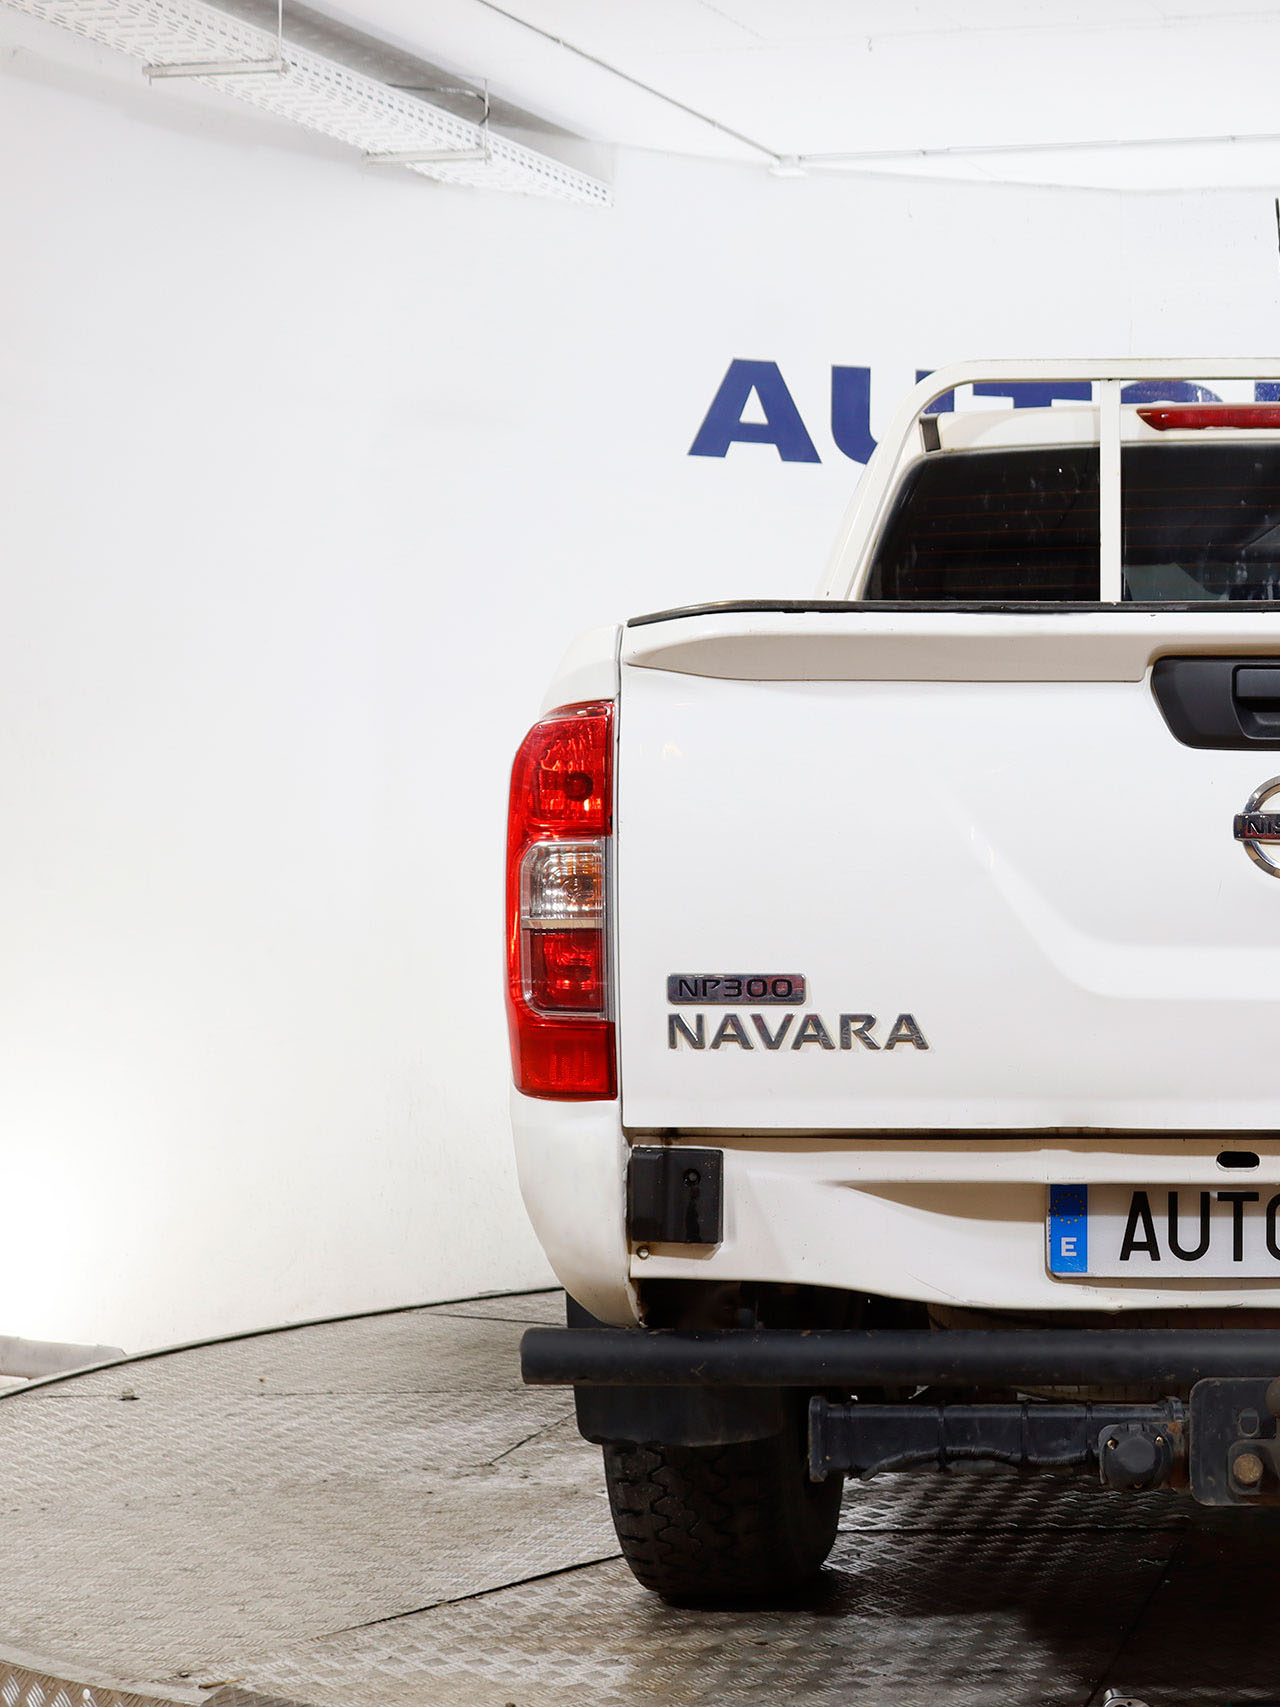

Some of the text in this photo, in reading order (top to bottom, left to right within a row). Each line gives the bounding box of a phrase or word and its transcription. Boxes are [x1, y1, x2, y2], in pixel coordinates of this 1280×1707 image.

[677, 978, 794, 998] NP300
[667, 1013, 930, 1051] NAVARA
[1060, 1236, 1078, 1257] E
